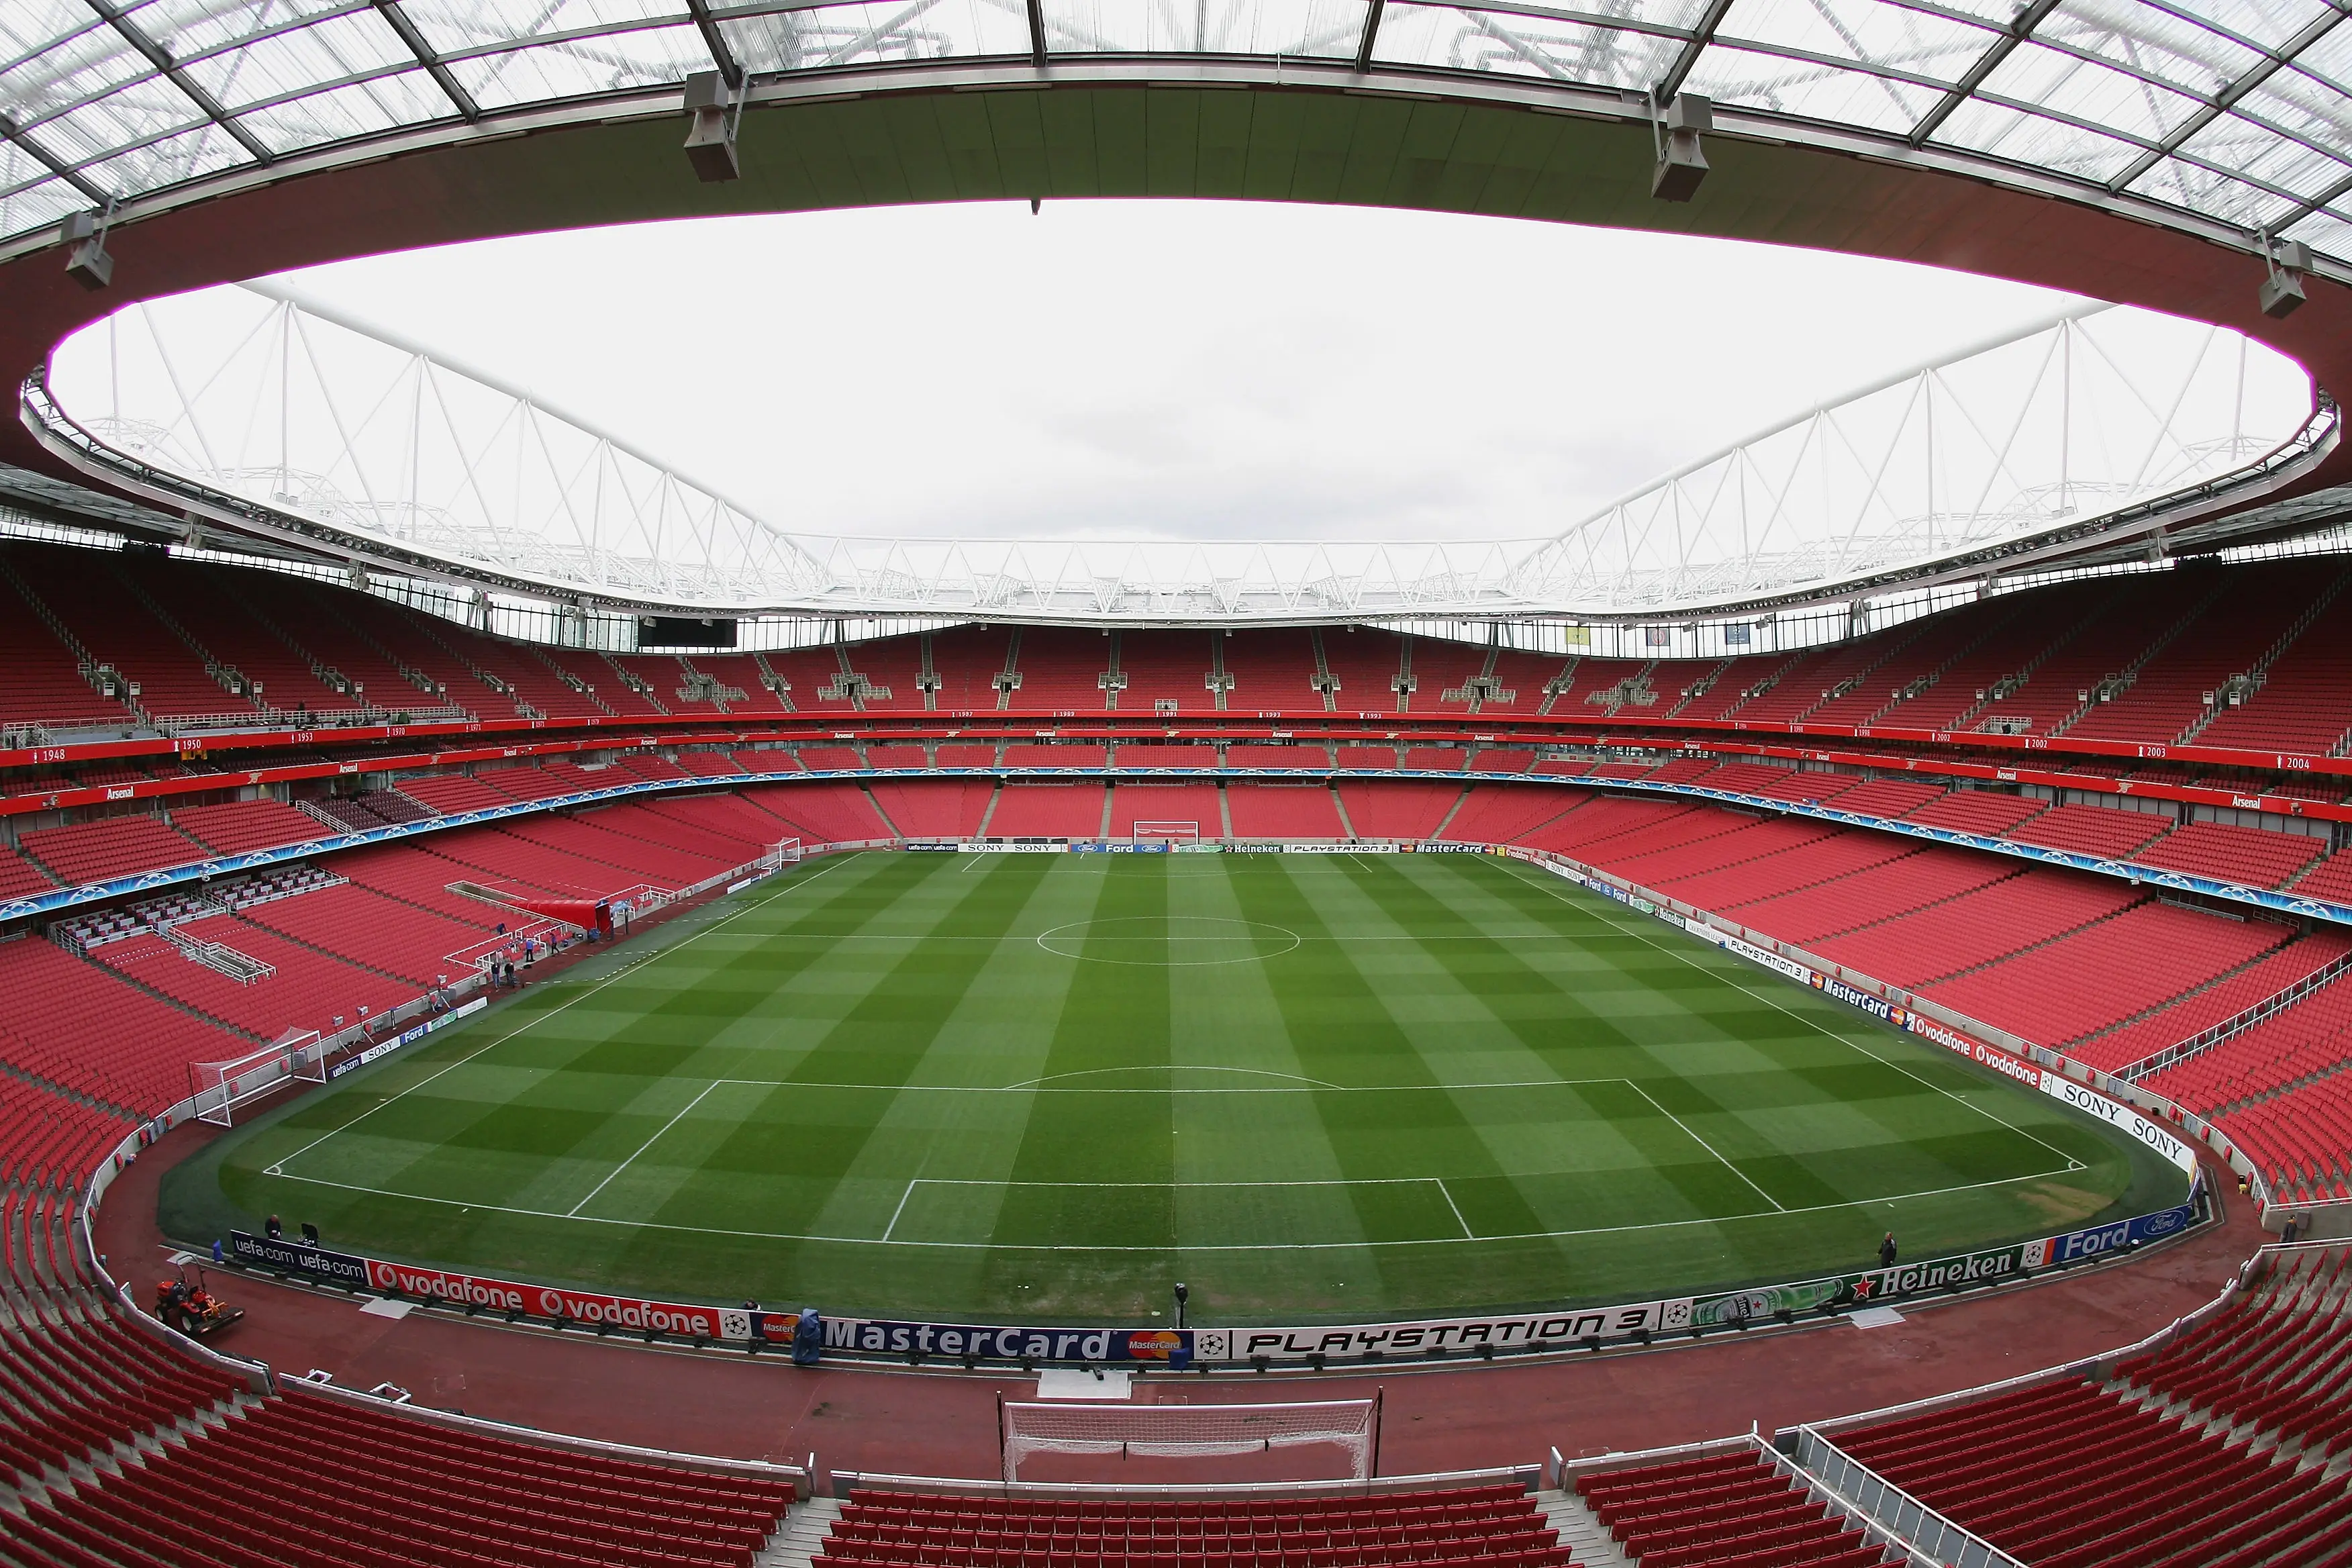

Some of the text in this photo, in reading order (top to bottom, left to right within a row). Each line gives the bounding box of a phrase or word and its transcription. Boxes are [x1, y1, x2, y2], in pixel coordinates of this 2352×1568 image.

[298, 733, 313, 742] 1953
[393, 728, 405, 736] 1970
[1937, 734, 1951, 742] 2002
[183, 740, 201, 750] 1950
[2032, 739, 2048, 748] 2002
[43, 750, 65, 761] 1948
[2147, 747, 2166, 757] 2003
[340, 763, 358, 773] Arsenal
[2287, 758, 2310, 769] 2004
[1997, 770, 2016, 781] Arsenal
[107, 786, 134, 800] Arsenal
[2233, 795, 2260, 809] Arsenal
[1106, 844, 1134, 852] Ford
[1234, 844, 1279, 853] Heineken
[1416, 844, 1482, 853] MasterCard
[1589, 878, 1601, 891] Ford
[1613, 888, 1626, 903] Ford
[1659, 908, 1684, 928] Heineken
[1731, 940, 1802, 977] PLAYSTATION 3
[1824, 979, 1888, 1018] MasterCard
[405, 1026, 424, 1043] Ford
[1925, 1025, 1971, 1055] vodafone
[369, 1041, 393, 1059] SONY
[1986, 1052, 2038, 1085] vodafone
[2065, 1085, 2183, 1161] SONY SONY
[2151, 1214, 2178, 1230] Ford
[2064, 1222, 2130, 1259] Ford
[1879, 1253, 2011, 1295] Heineken
[399, 1273, 524, 1309] vodafone
[566, 1299, 709, 1334] vodafone
[763, 1323, 795, 1333] MasterC
[1246, 1310, 1648, 1353] PLAYSTATION 3
[824, 1320, 1111, 1360] MasterCard
[1129, 1340, 1181, 1350] MasterCard
